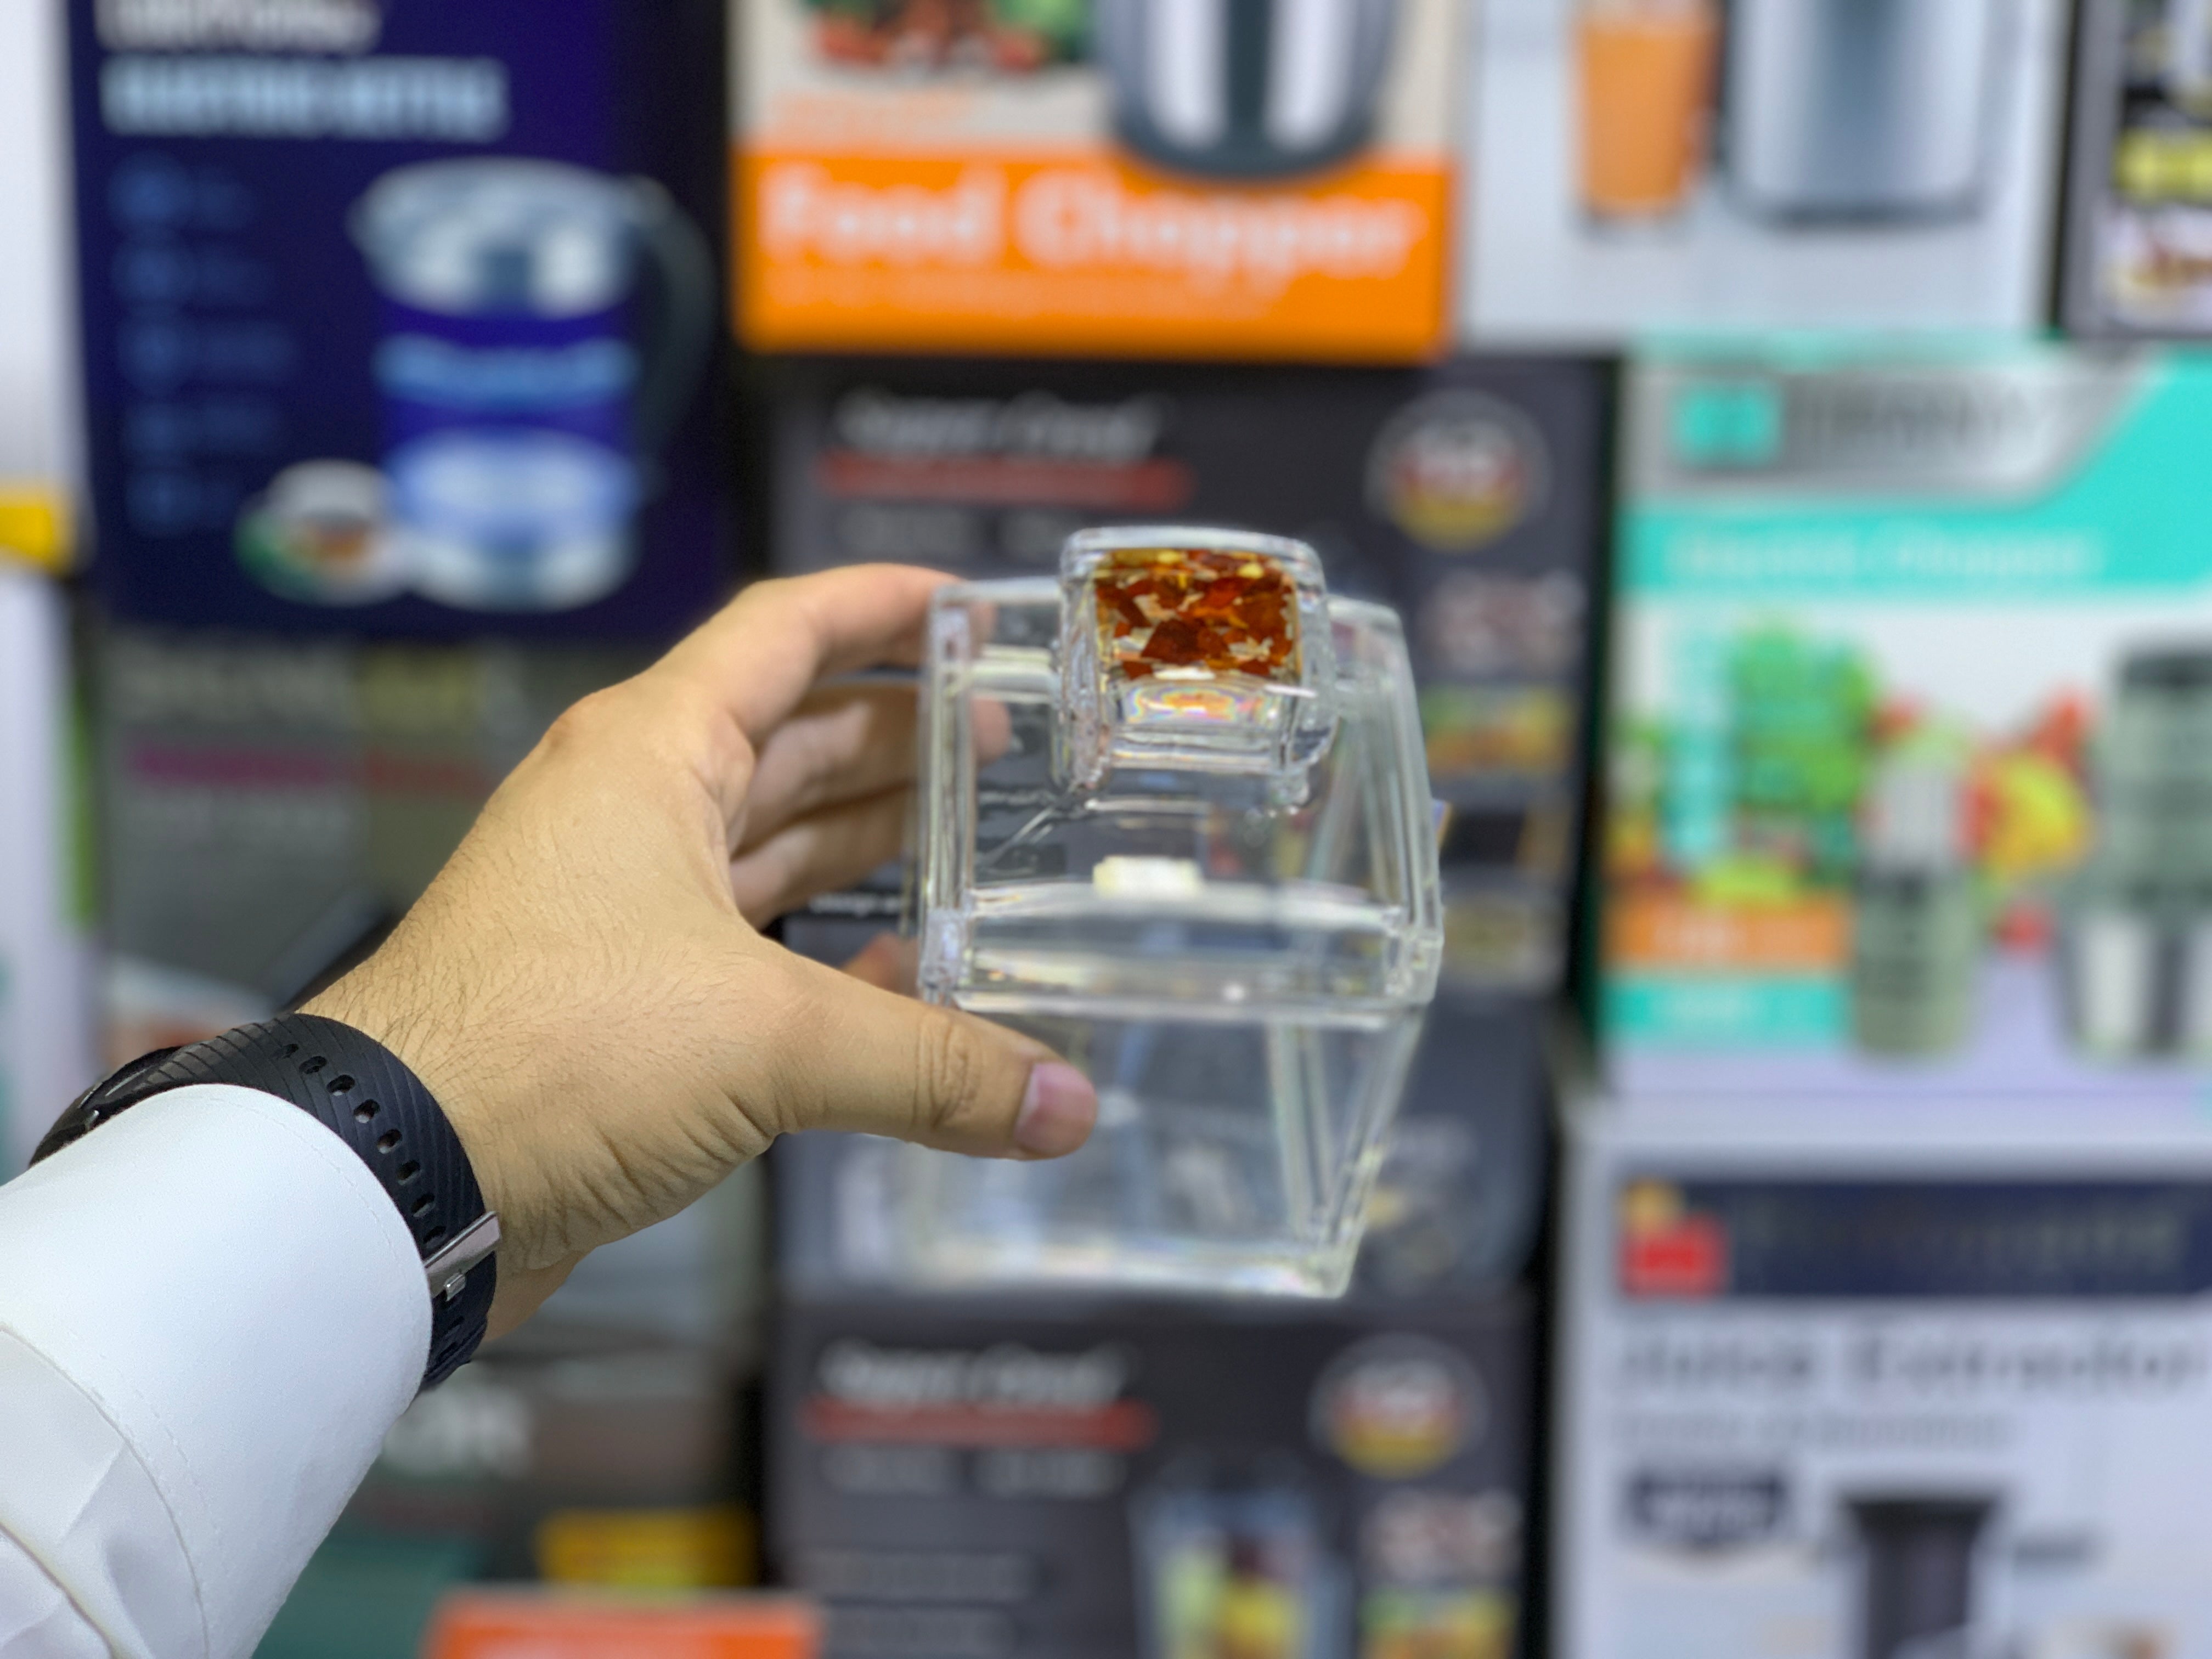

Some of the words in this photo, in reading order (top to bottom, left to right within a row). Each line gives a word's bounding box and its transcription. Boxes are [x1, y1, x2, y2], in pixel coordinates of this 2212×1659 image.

[766, 169, 1000, 259] Food
[1019, 172, 1422, 292] Chopper
[1611, 1325, 1828, 1393] Juice
